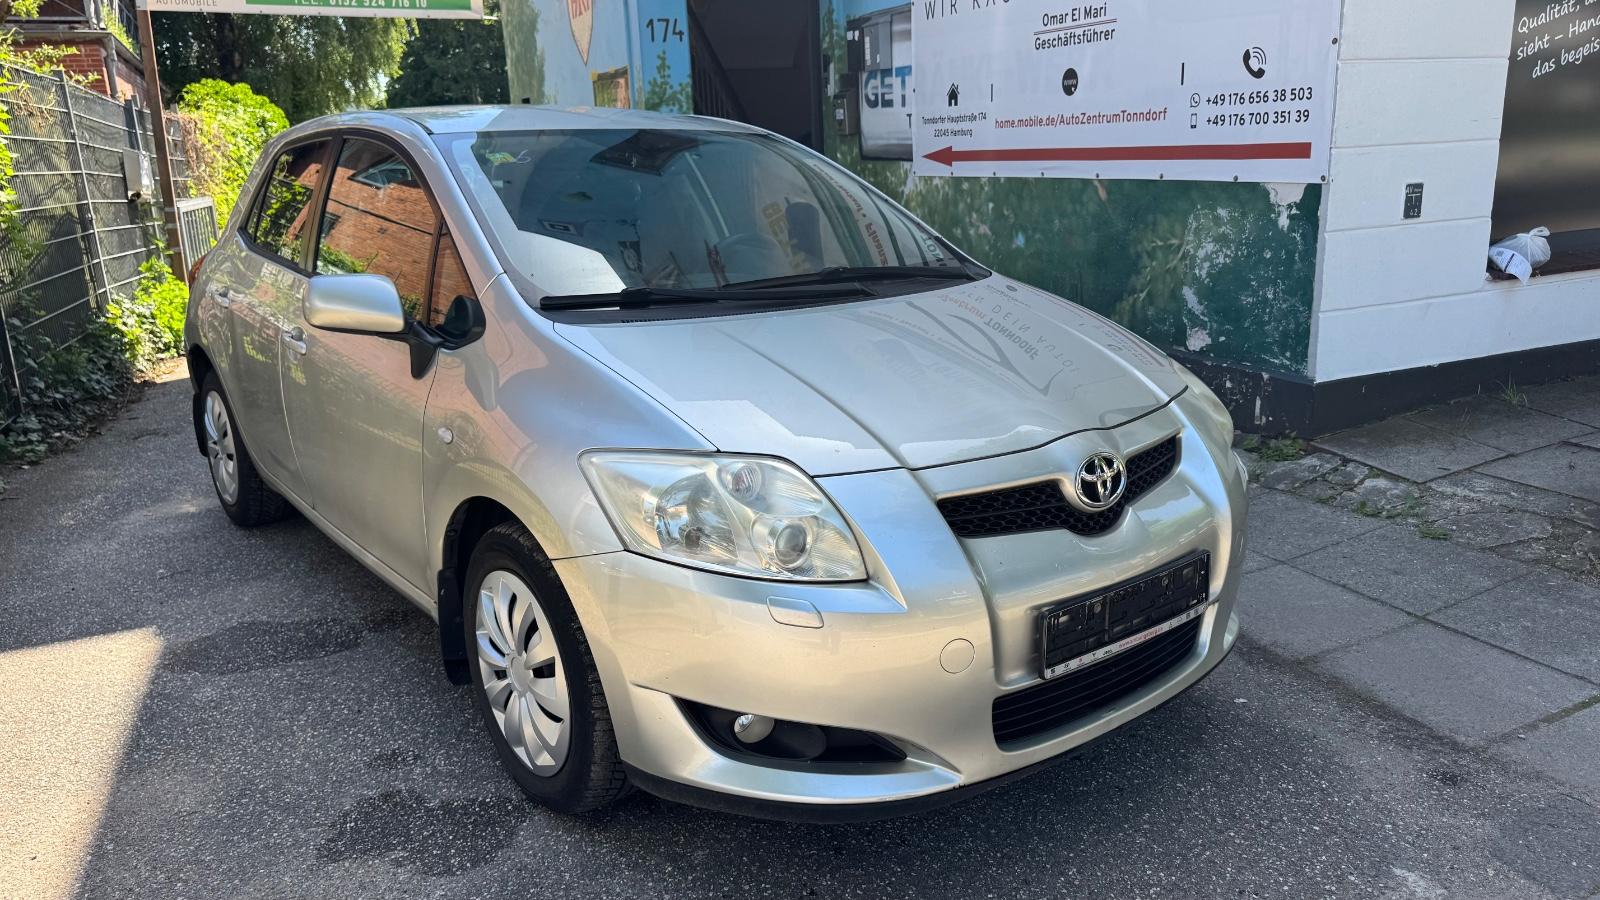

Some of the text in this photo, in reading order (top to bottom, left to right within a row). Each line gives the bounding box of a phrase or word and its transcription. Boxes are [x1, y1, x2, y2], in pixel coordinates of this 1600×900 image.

[924, 0, 958, 20] WIR
[1042, 2, 1107, 27] Omar El Mari
[1518, 0, 1580, 33] Qualität,
[646, 18, 685, 43] 174
[1034, 28, 1116, 51] Geschäftsführer
[1517, 33, 1551, 61] sieht
[1532, 58, 1556, 79] das
[864, 65, 912, 110] GET
[1206, 86, 1313, 107] +49 176 656 38 503
[978, 111, 987, 121] 174
[995, 107, 1168, 129] home.mobile.de/AutoZentrumTonndorf
[1206, 109, 1310, 127] +49 176 700 351 39
[934, 128, 973, 138] 22045 Hamburg
